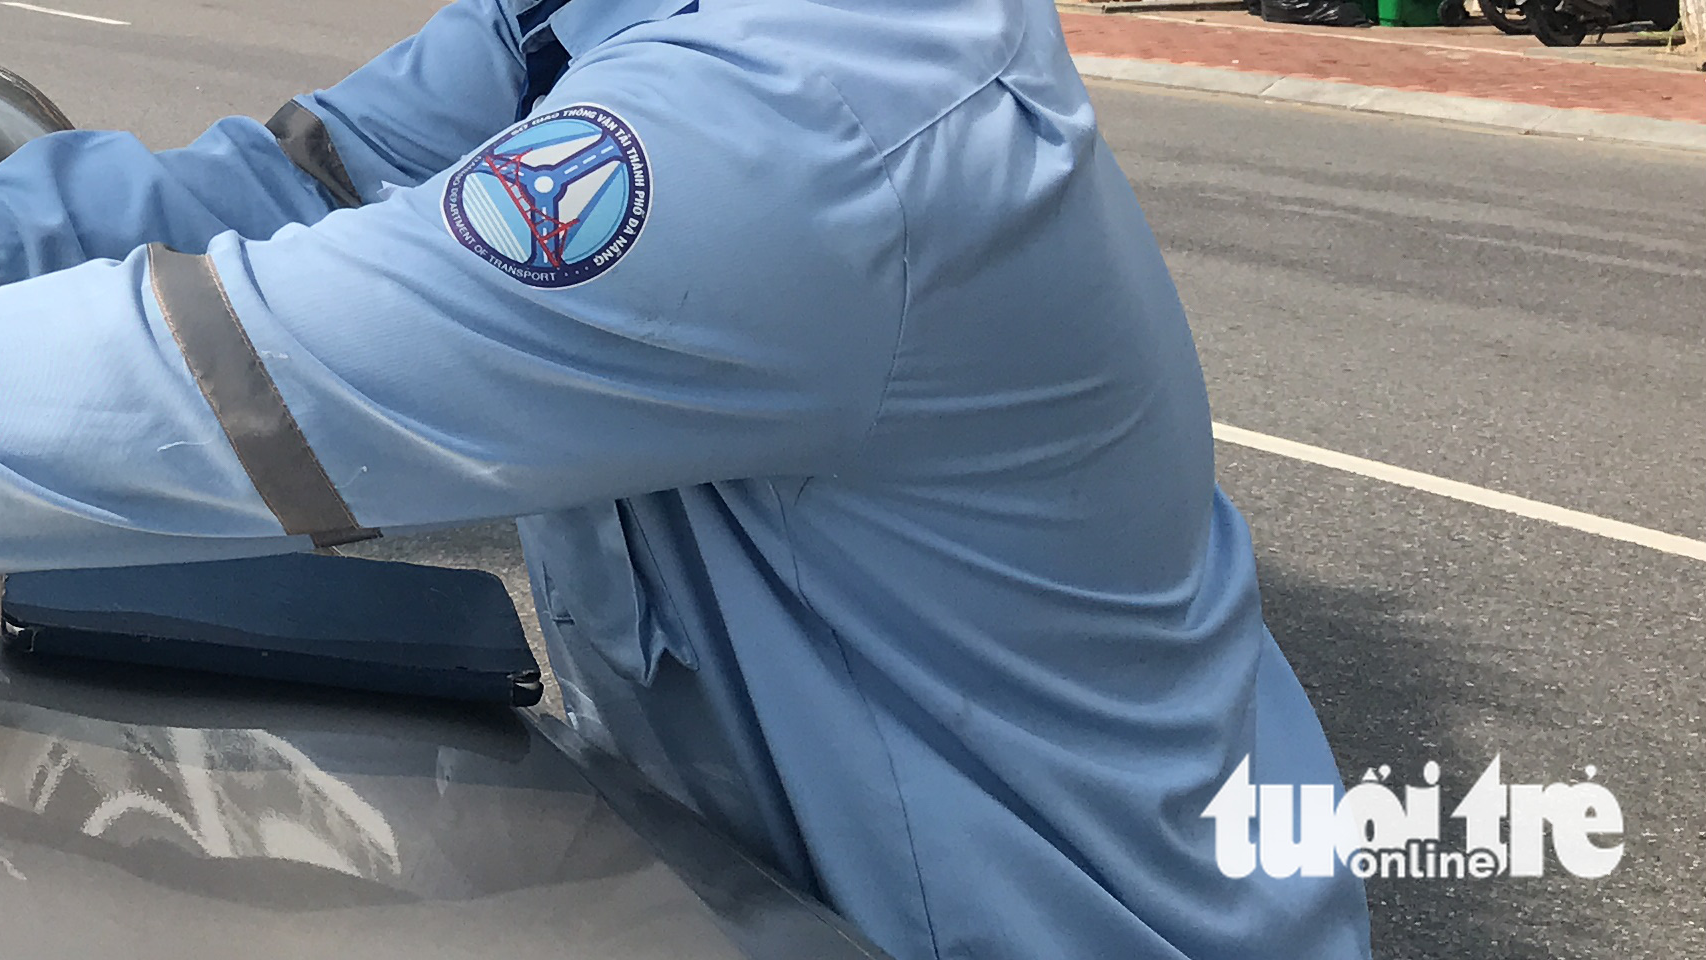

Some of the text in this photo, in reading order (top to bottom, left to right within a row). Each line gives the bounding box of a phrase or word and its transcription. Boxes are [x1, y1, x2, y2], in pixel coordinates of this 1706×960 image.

[532, 113, 560, 126] GIAO
[563, 107, 598, 120] THÔNG
[597, 113, 618, 132] VẬN
[615, 128, 632, 147] TẢI
[626, 147, 645, 187] THÀNH
[632, 190, 646, 218] PHỐ
[474, 244, 489, 256] OF
[489, 254, 556, 281] TRANSPORT
